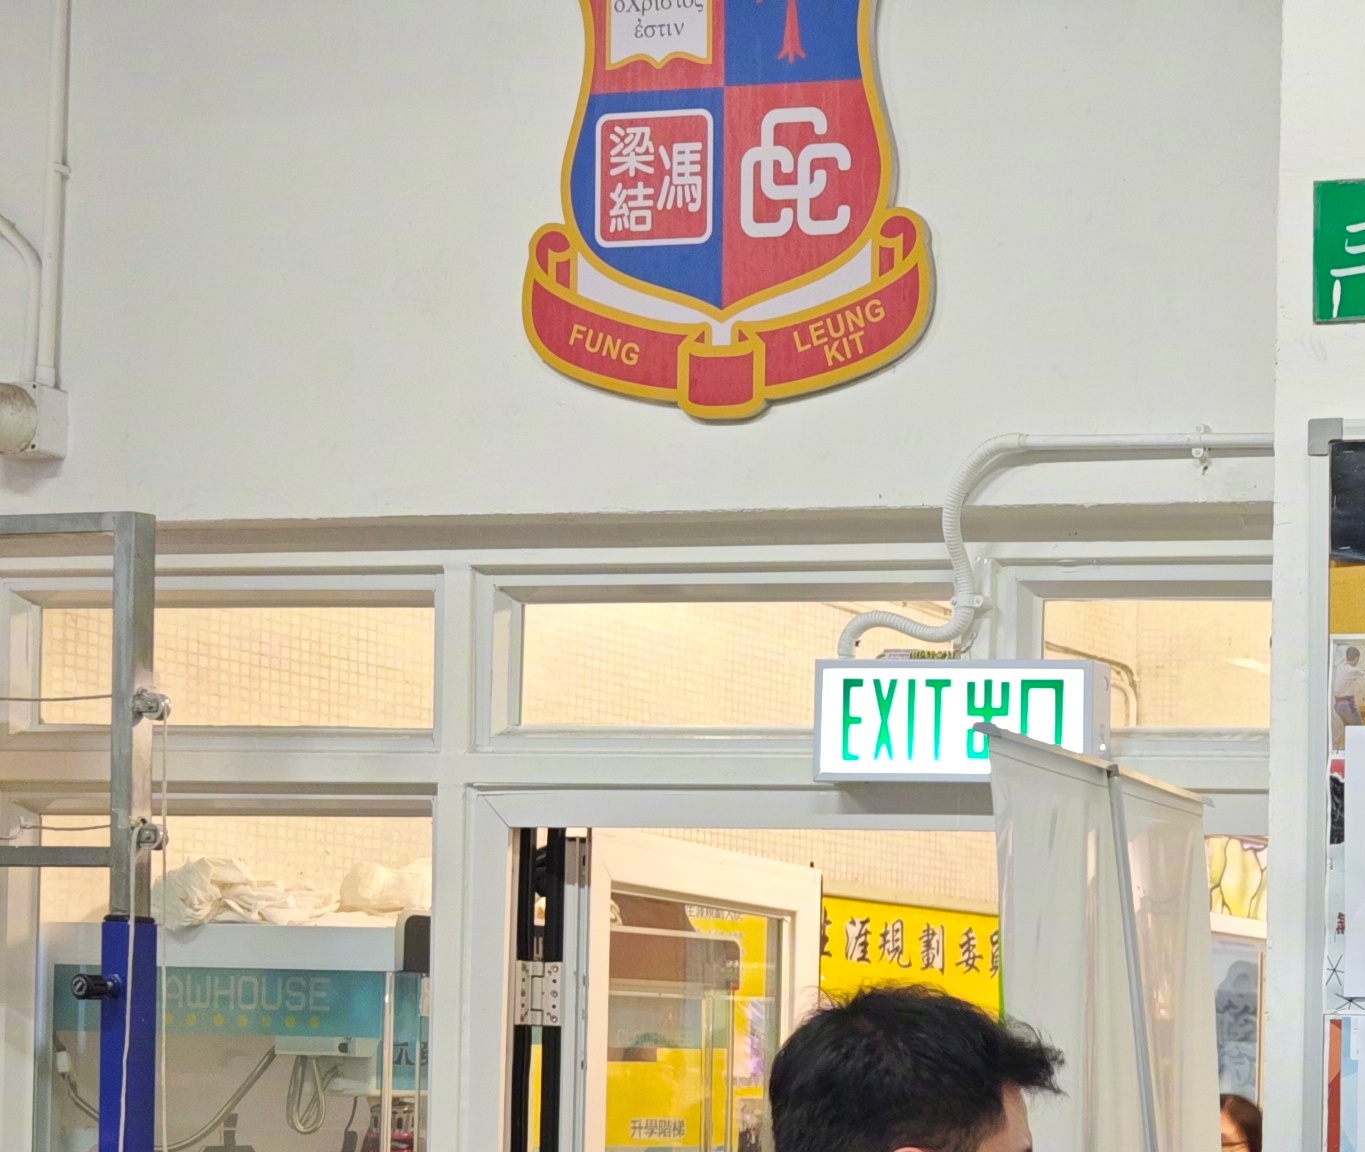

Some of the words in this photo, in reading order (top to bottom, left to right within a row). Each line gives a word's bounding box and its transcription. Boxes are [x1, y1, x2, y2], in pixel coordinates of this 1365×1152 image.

[568, 323, 640, 366] FUNG
[792, 299, 886, 353] LEUNG
[824, 331, 865, 366] KIT
[842, 678, 952, 761] EXIT
[166, 976, 332, 1013] AWHOUSE
